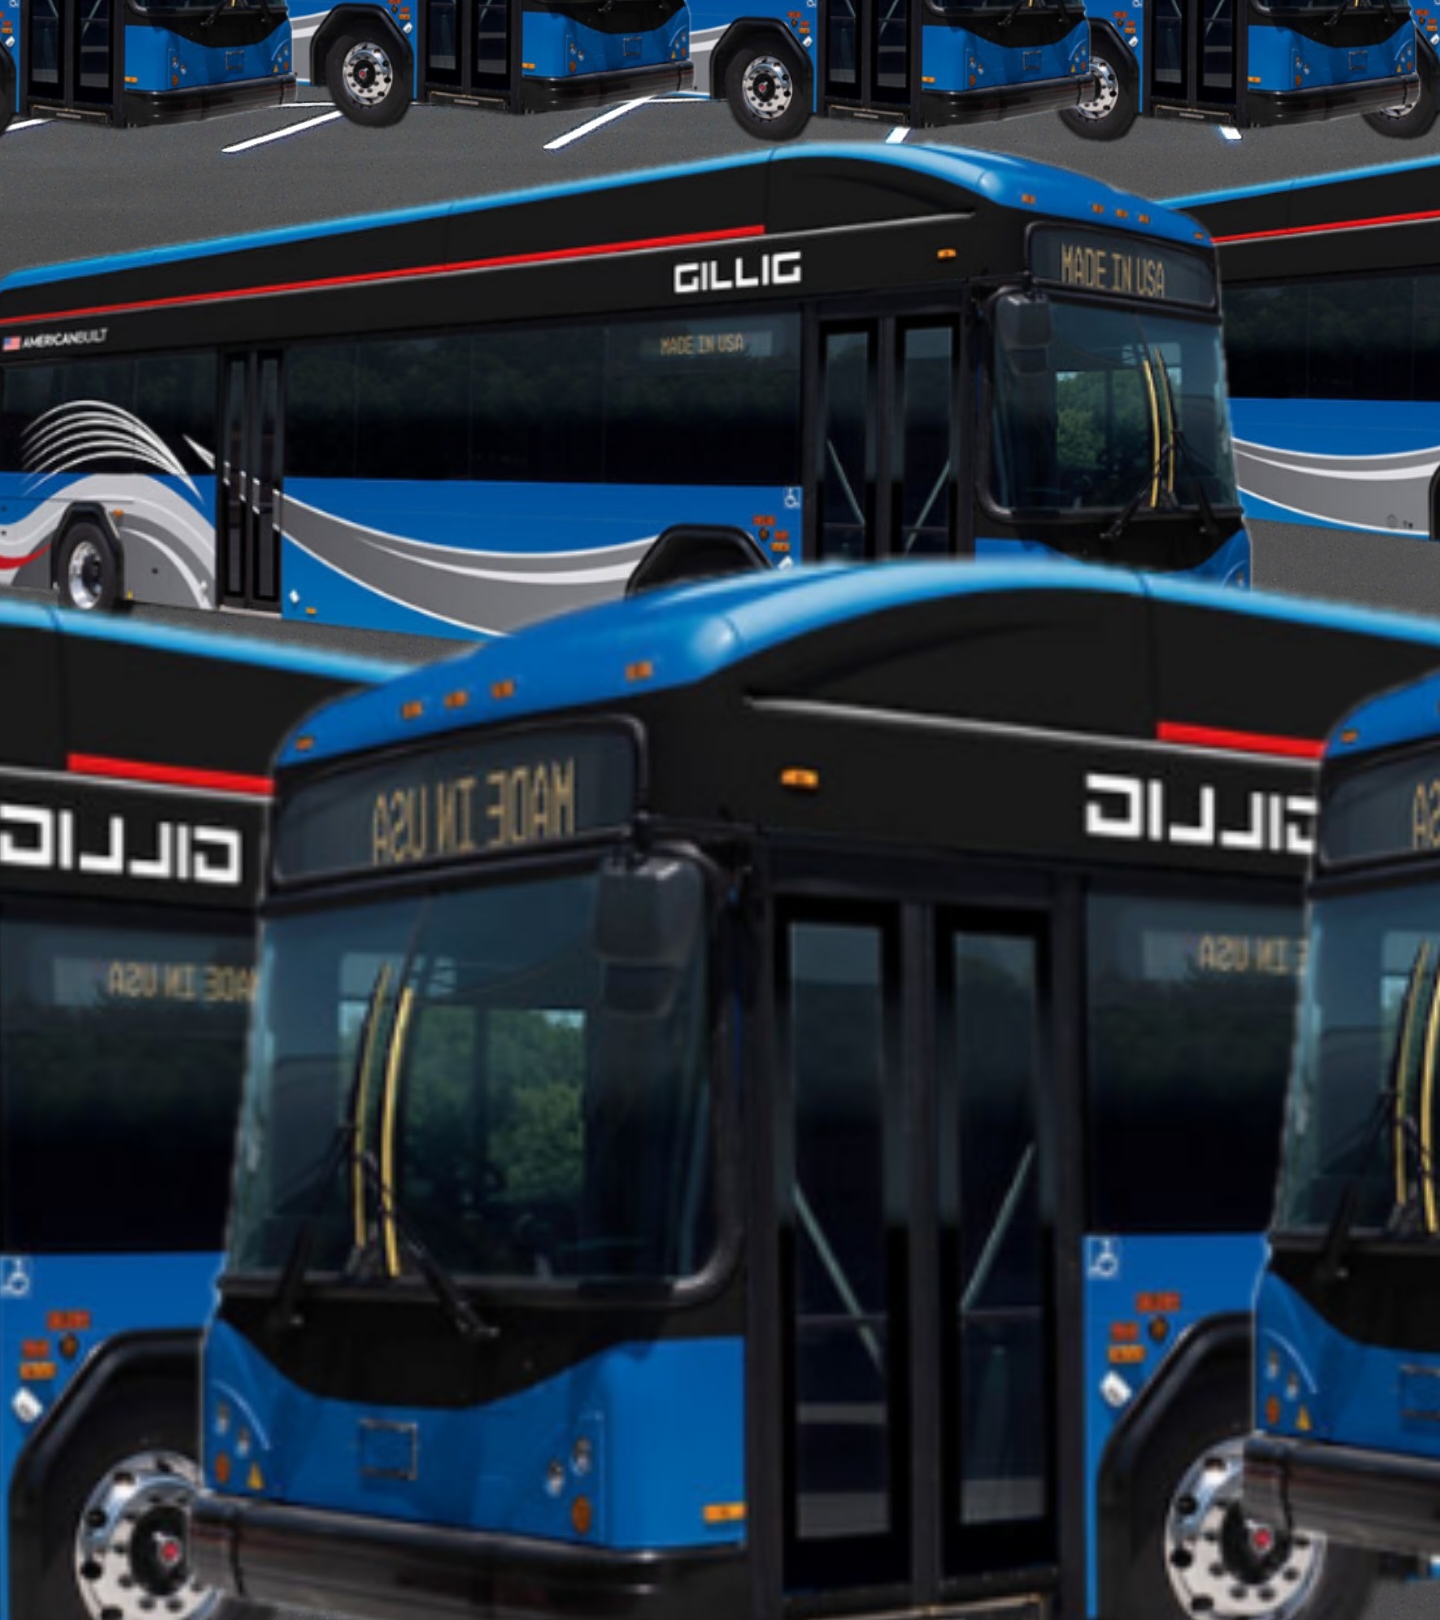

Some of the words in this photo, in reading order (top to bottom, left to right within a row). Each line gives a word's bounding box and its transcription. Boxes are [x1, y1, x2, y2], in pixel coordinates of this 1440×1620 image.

[674, 251, 802, 294] GILLIG
[1061, 247, 1106, 287] MADE
[1112, 252, 1132, 292] IN
[1137, 259, 1164, 297] USA
